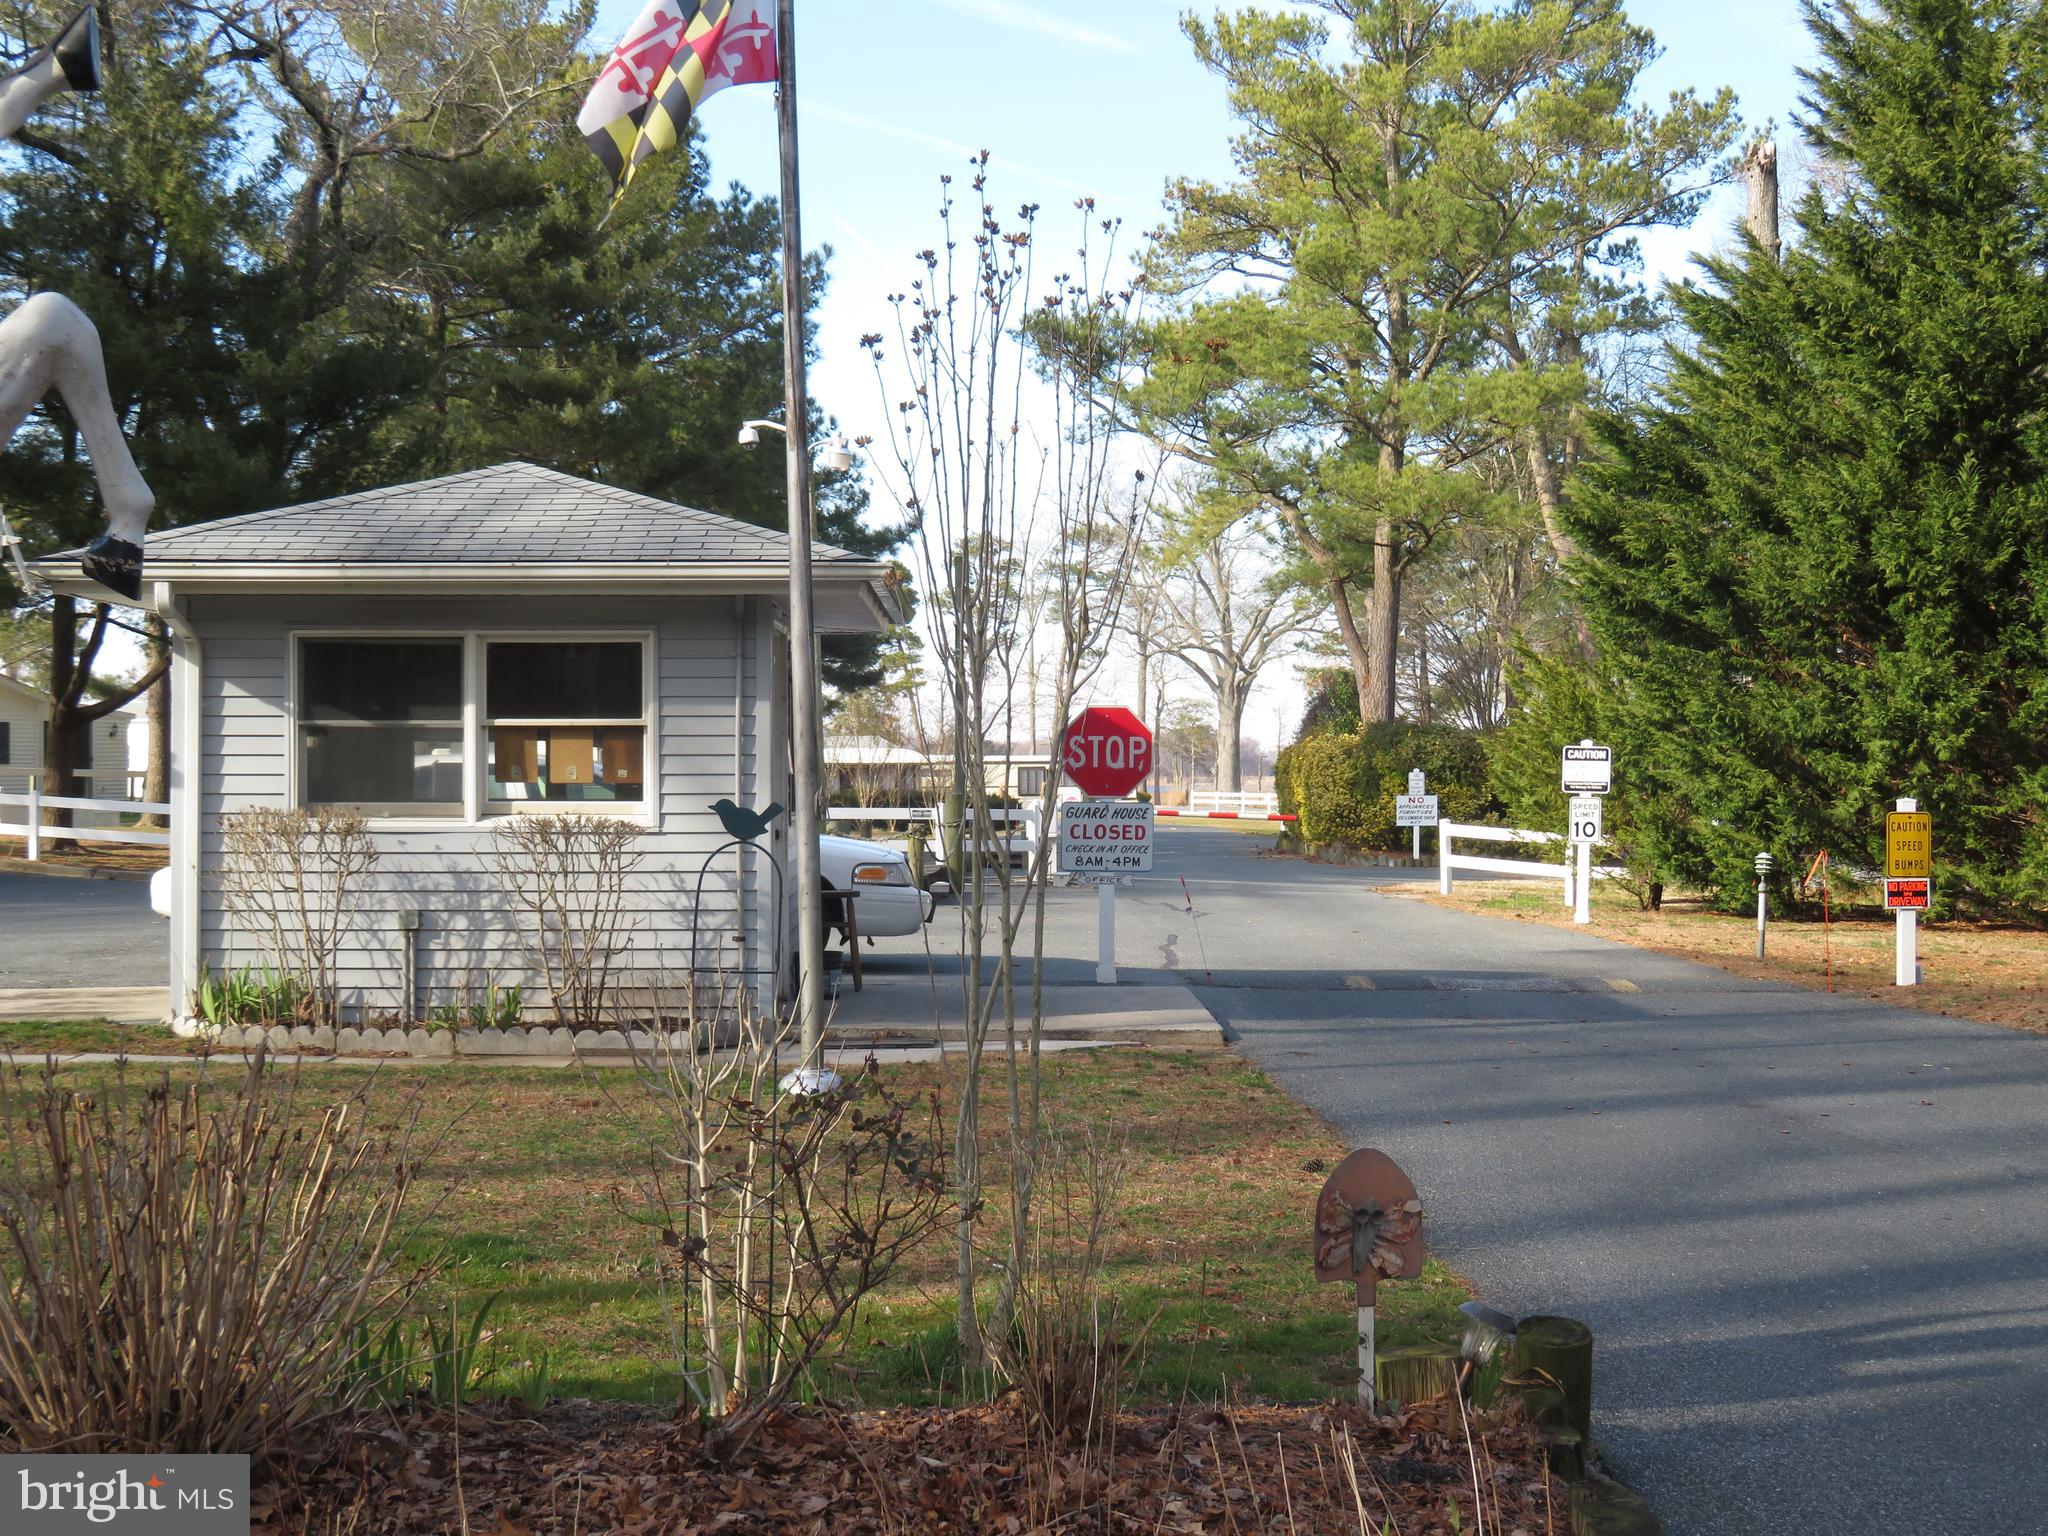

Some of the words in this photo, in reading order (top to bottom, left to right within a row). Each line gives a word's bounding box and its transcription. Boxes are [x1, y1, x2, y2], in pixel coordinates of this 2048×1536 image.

[1069, 735, 1147, 769] STOP
[1567, 749, 1607, 760] CAUTION
[1408, 796, 1424, 804] NO
[1573, 803, 1598, 811] SPEED
[1066, 806, 1108, 820] GUARD
[1111, 806, 1150, 820] HOUSE
[1573, 821, 1596, 838] 10
[1890, 821, 1928, 832] CAUTION
[1069, 824, 1147, 841] CLOSED
[1065, 844, 1094, 853] CHECK
[1095, 845, 1106, 853] IN
[1108, 845, 1118, 853] AT
[1120, 845, 1150, 854] OFFICE
[1896, 840, 1923, 851] SPEED
[1075, 856, 1103, 867] 8AM
[1112, 856, 1141, 867] 4PM
[1894, 859, 1924, 870] BUMPS
[1888, 881, 1898, 892] NO
[1899, 881, 1927, 892] PARKING
[1888, 896, 1927, 906] DRIVEWAY
